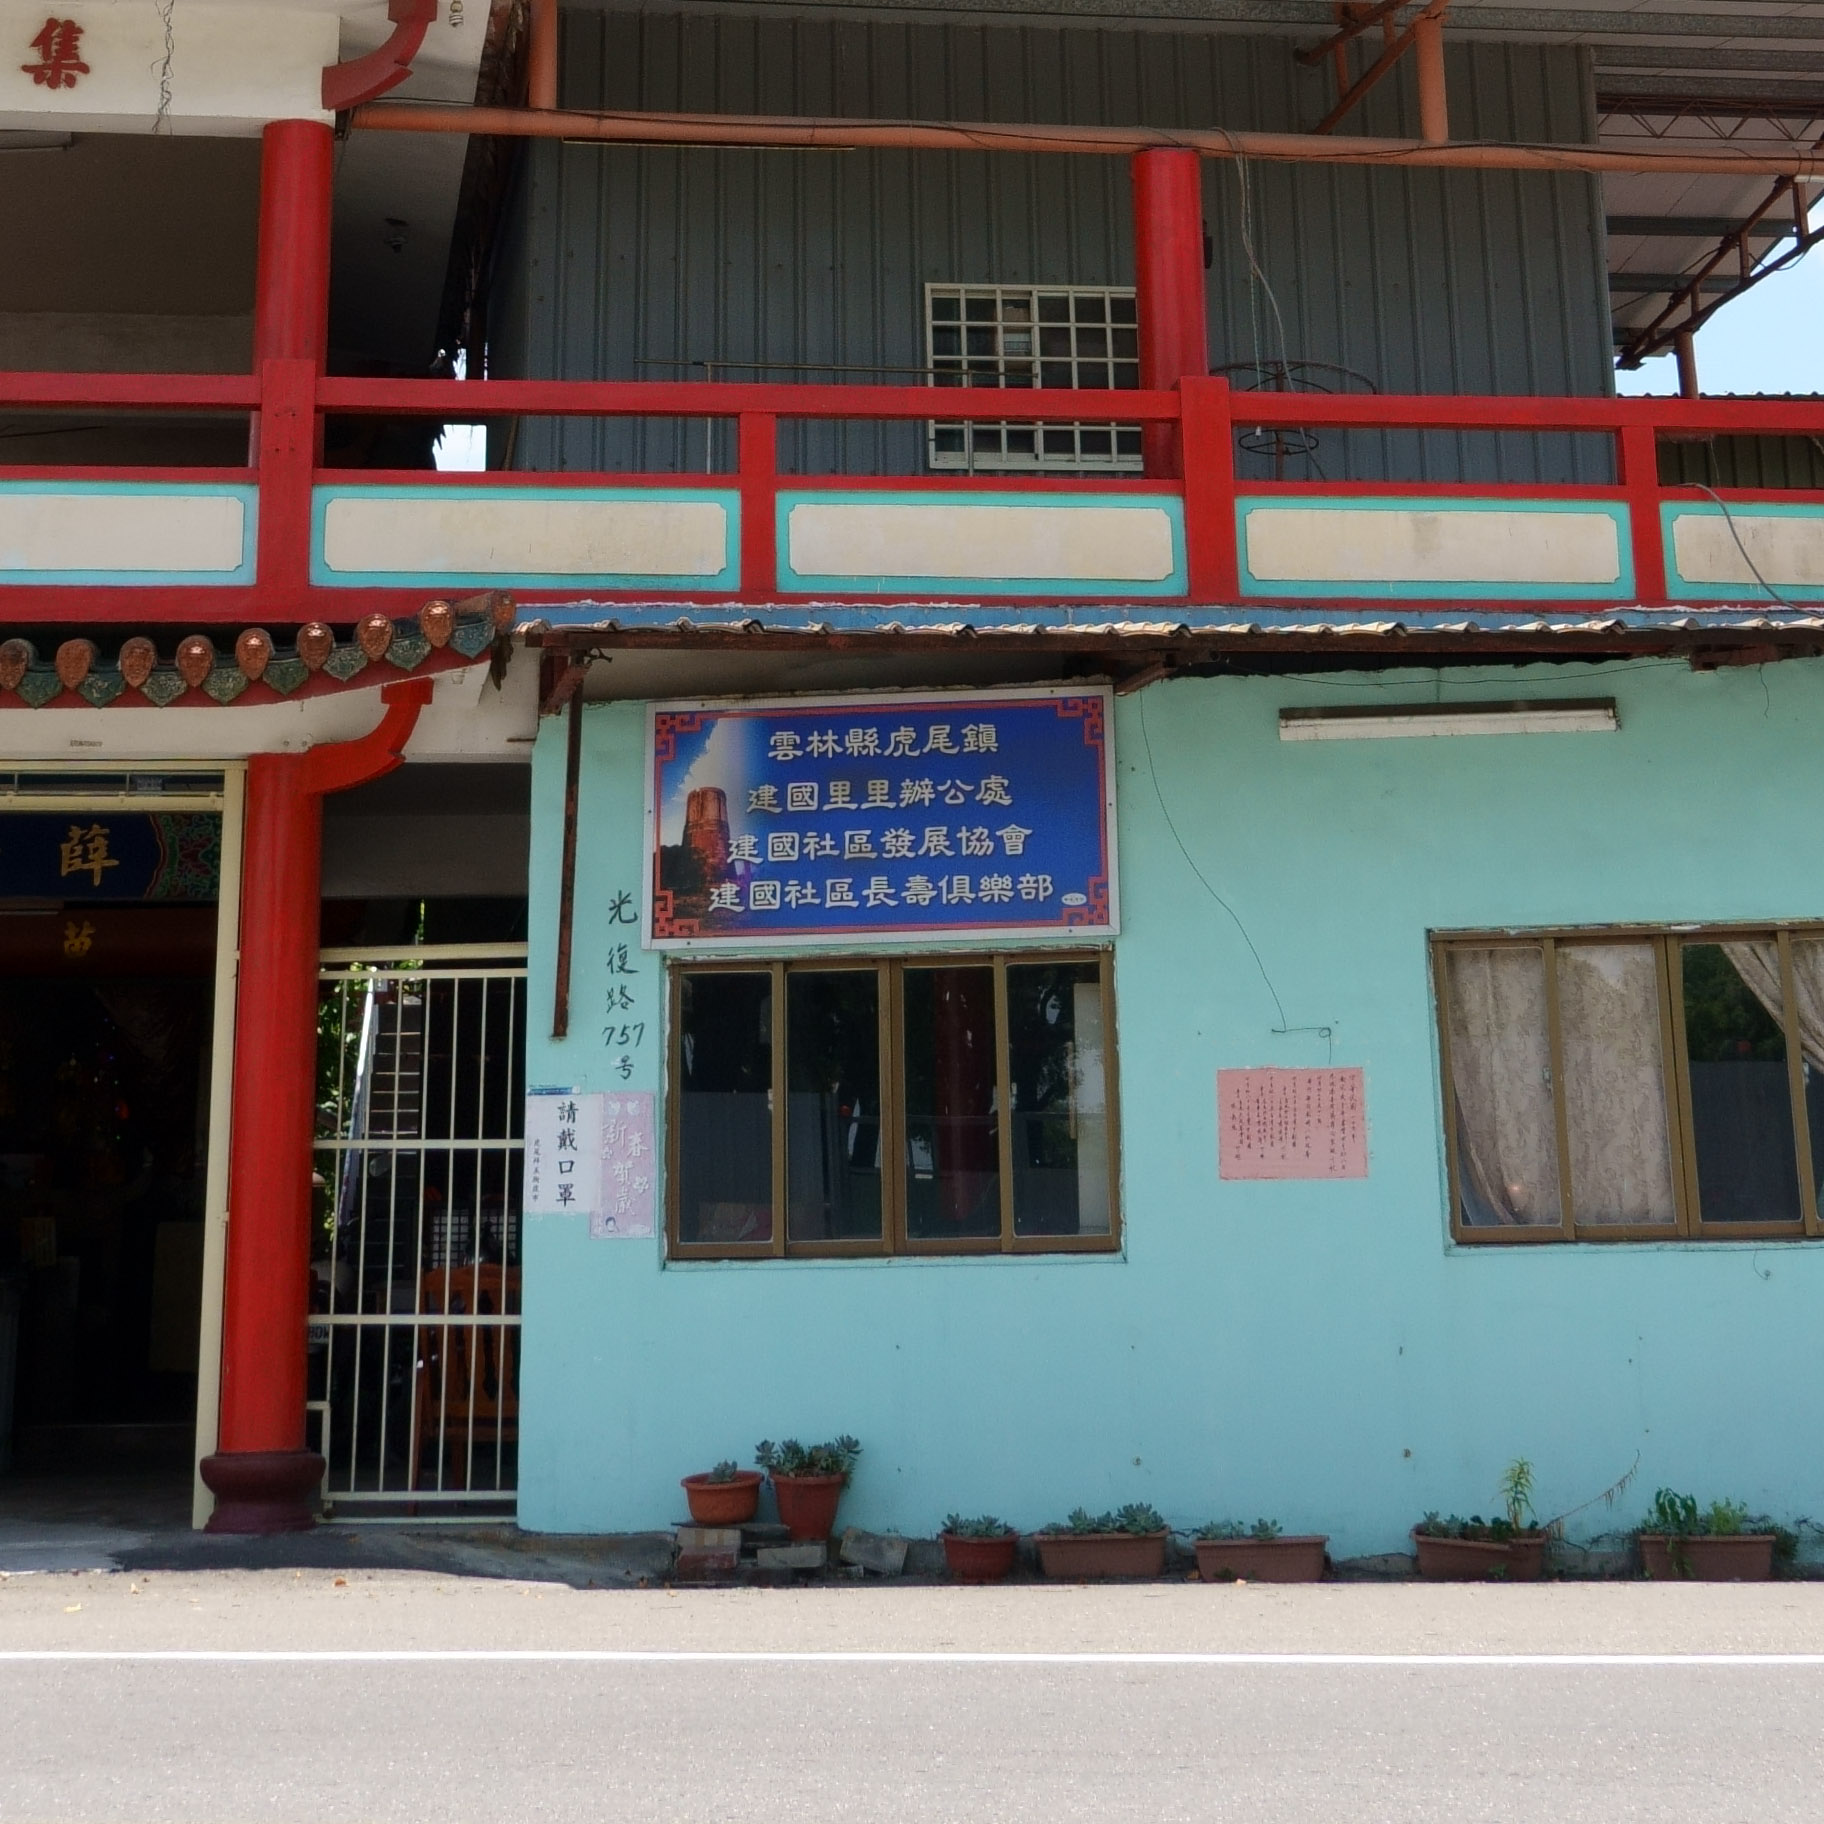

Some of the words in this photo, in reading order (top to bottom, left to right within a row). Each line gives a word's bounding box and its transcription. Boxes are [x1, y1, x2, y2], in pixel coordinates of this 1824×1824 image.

[767, 722, 999, 761] 雲林縣虎尾鎮
[746, 774, 1014, 814] 建國里里辦公處
[727, 823, 1034, 865] 建國社區發展協會
[708, 872, 1054, 914] 建國社區長壽俱樂部
[556, 1100, 580, 1208] 請戴口罩
